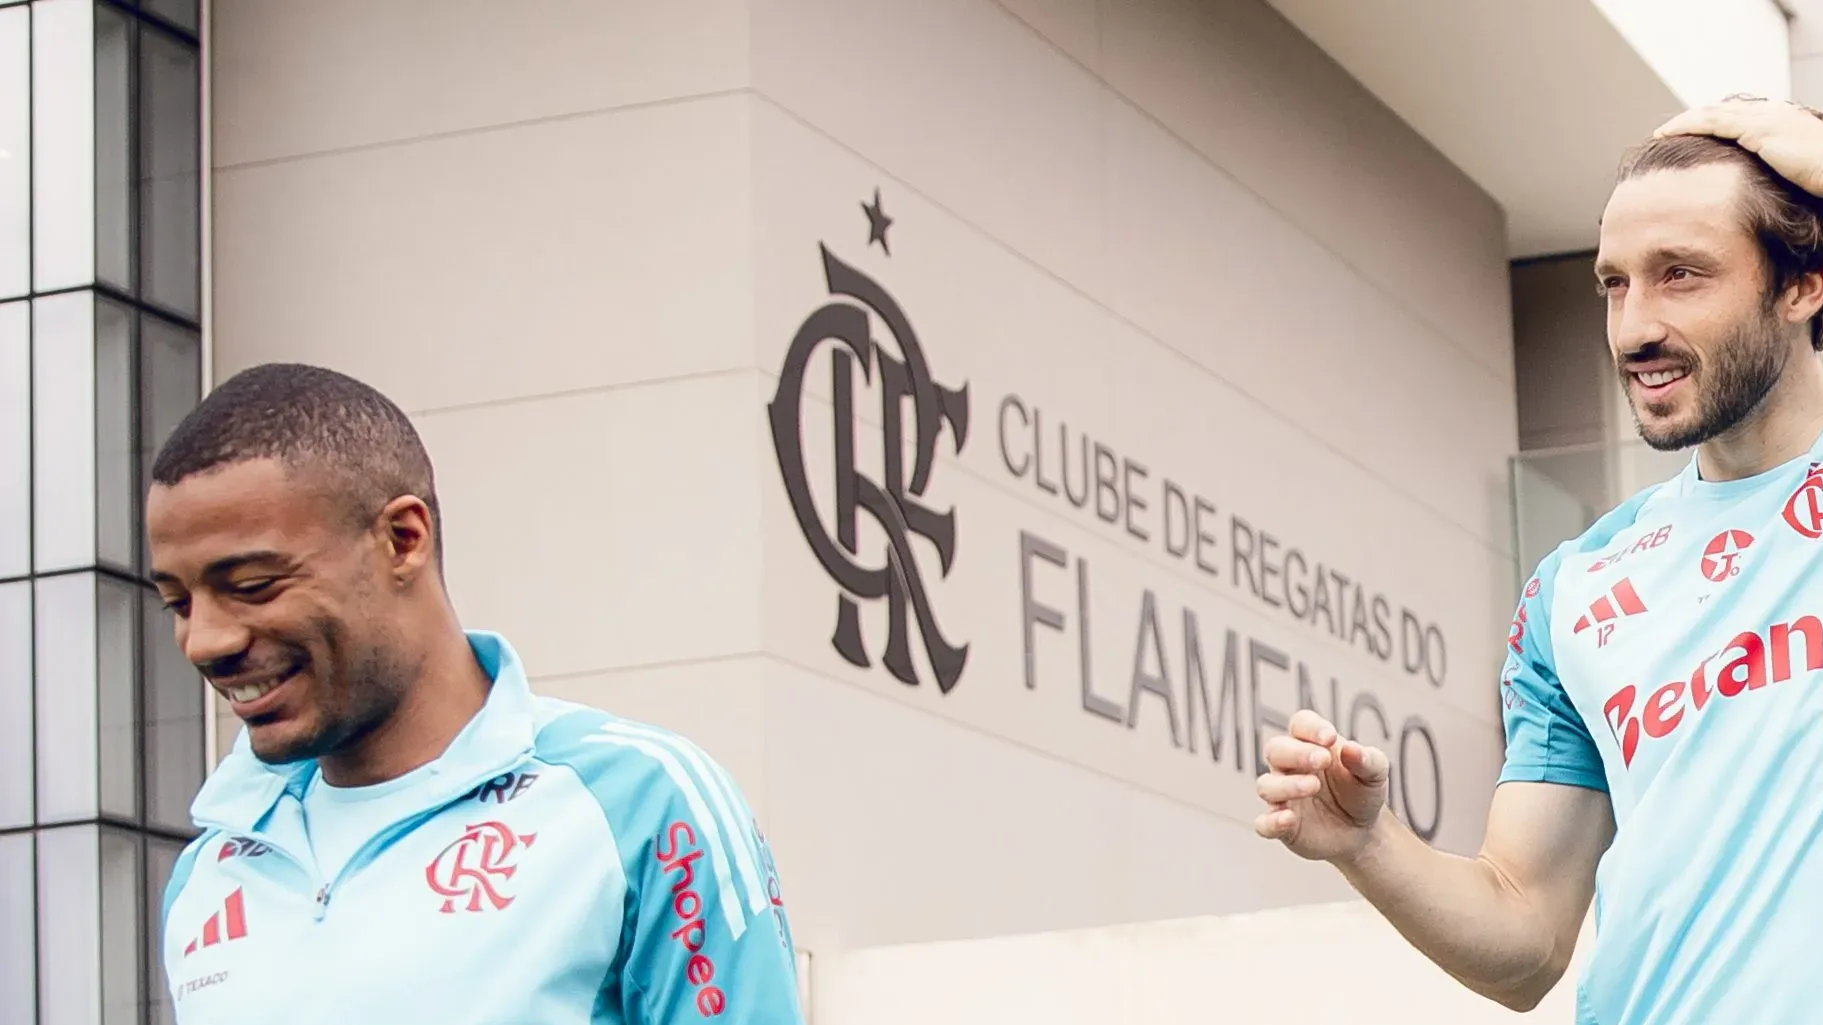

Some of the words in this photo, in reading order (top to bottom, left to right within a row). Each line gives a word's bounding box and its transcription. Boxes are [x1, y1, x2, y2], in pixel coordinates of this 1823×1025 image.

[998, 393, 1150, 542] CLUBE
[1164, 478, 1219, 577] DE
[1231, 513, 1393, 662] REGATAS
[1401, 606, 1447, 688] DO
[1597, 623, 1614, 648] 17
[655, 821, 726, 1018] Shopee
